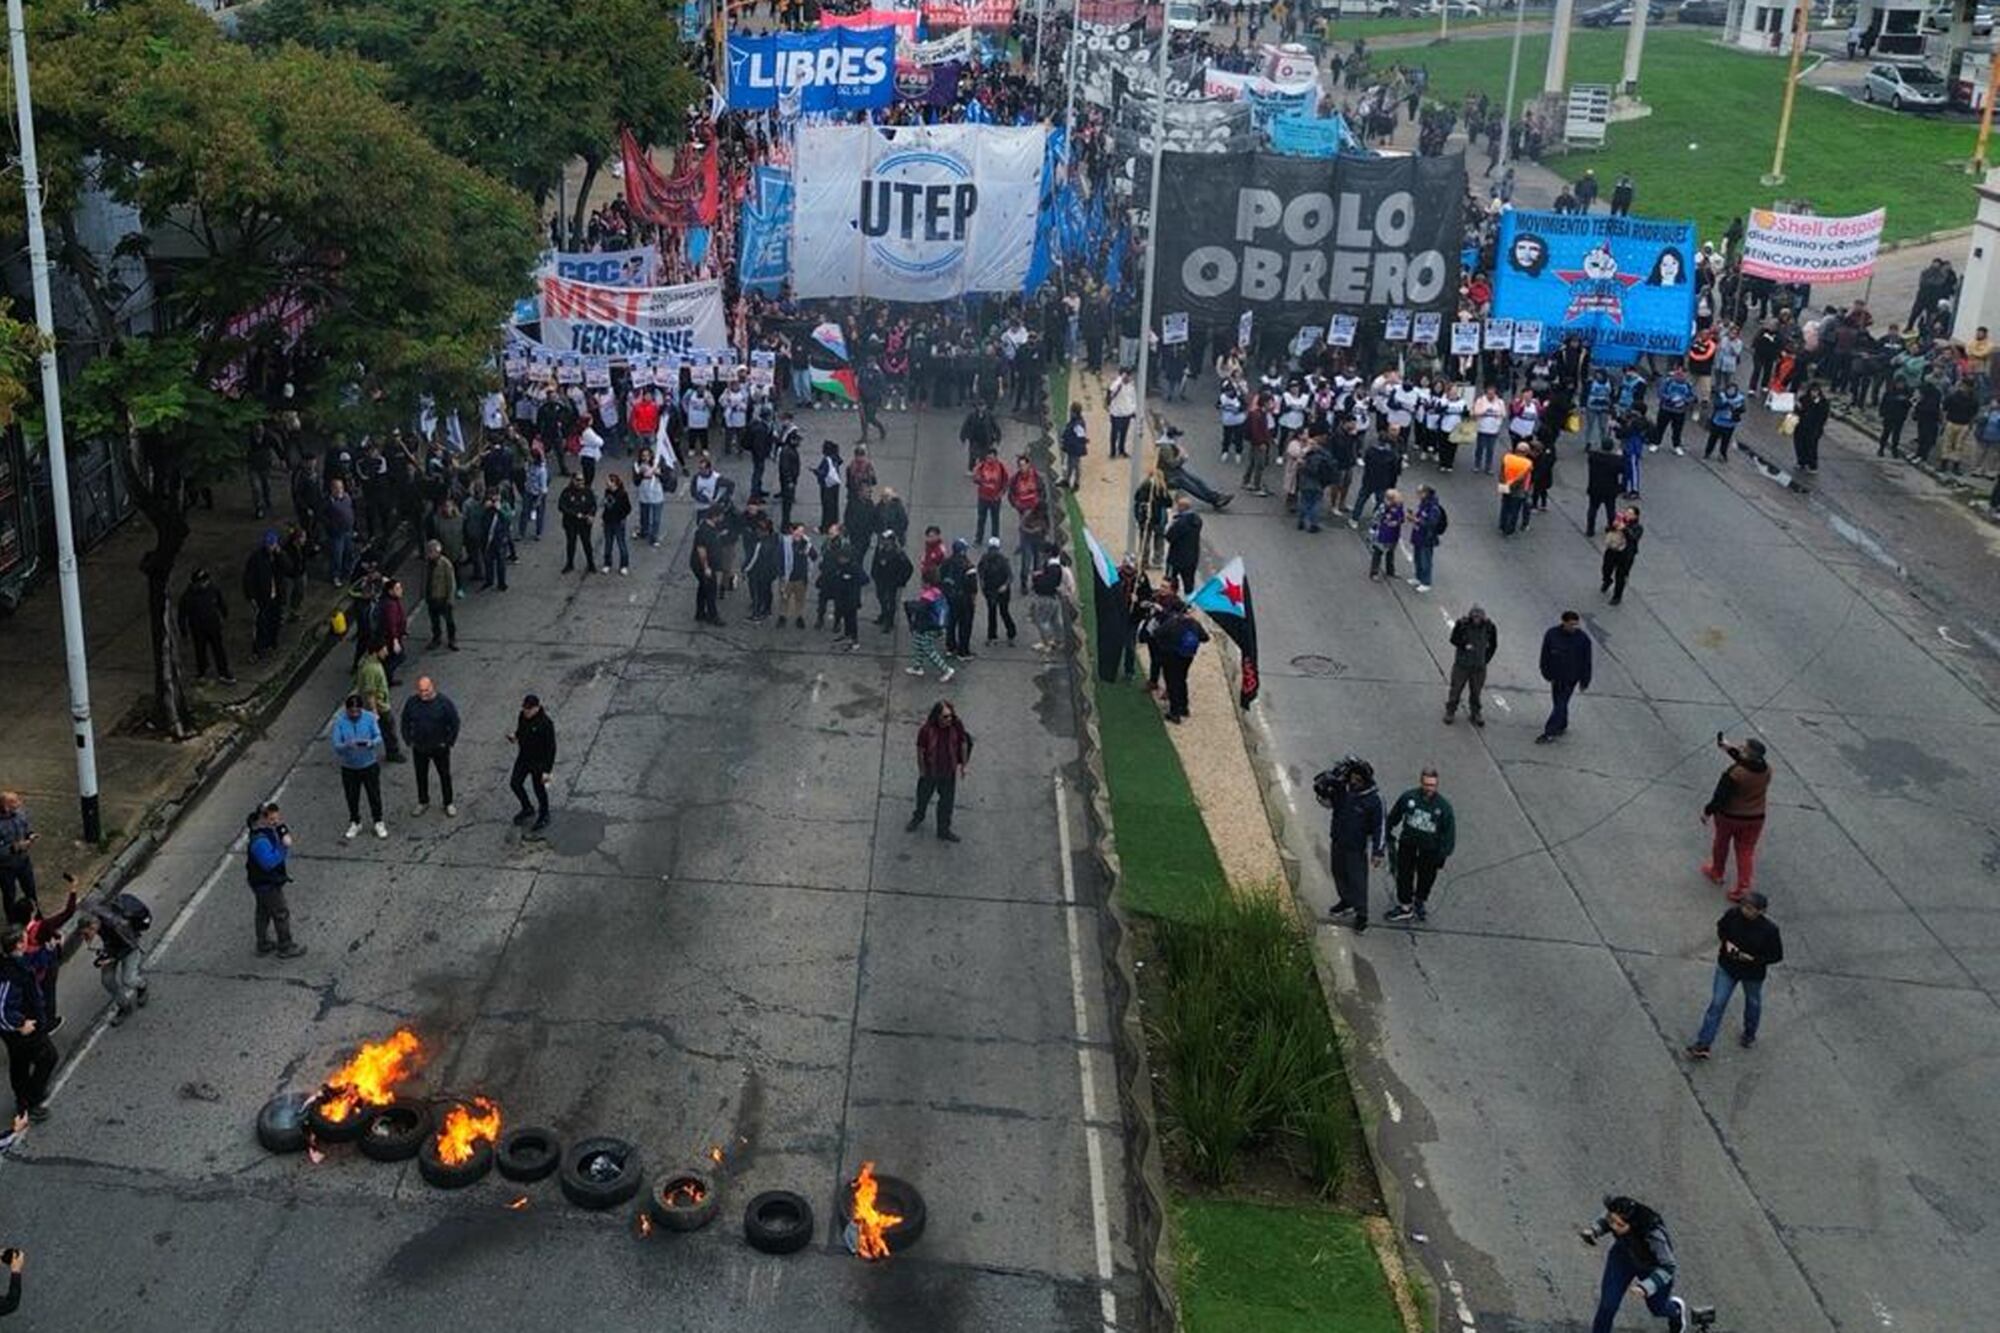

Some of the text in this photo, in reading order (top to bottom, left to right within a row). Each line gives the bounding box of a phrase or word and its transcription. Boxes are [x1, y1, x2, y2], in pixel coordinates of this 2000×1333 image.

[1074, 33, 1131, 50] POLO
[750, 47, 887, 89] LIBRES
[859, 180, 978, 241] UTEP
[1235, 188, 1415, 247] POLO
[1514, 213, 1590, 237] MOVIMIENTO
[1592, 219, 1630, 238] TERESA
[1777, 217, 1823, 238] Shell
[1748, 230, 1817, 251] discrimina
[1819, 242, 1826, 252] y
[1744, 247, 1868, 269] REINCORPORACIÓN
[558, 259, 621, 283] CCC
[1181, 246, 1446, 304] OBRERO
[544, 276, 650, 326] MST
[649, 315, 694, 328] TRABAJO
[571, 324, 695, 355] TERESA VIVE
[1606, 330, 1646, 346] CAMBIO
[1647, 334, 1682, 351] SOCIAL
